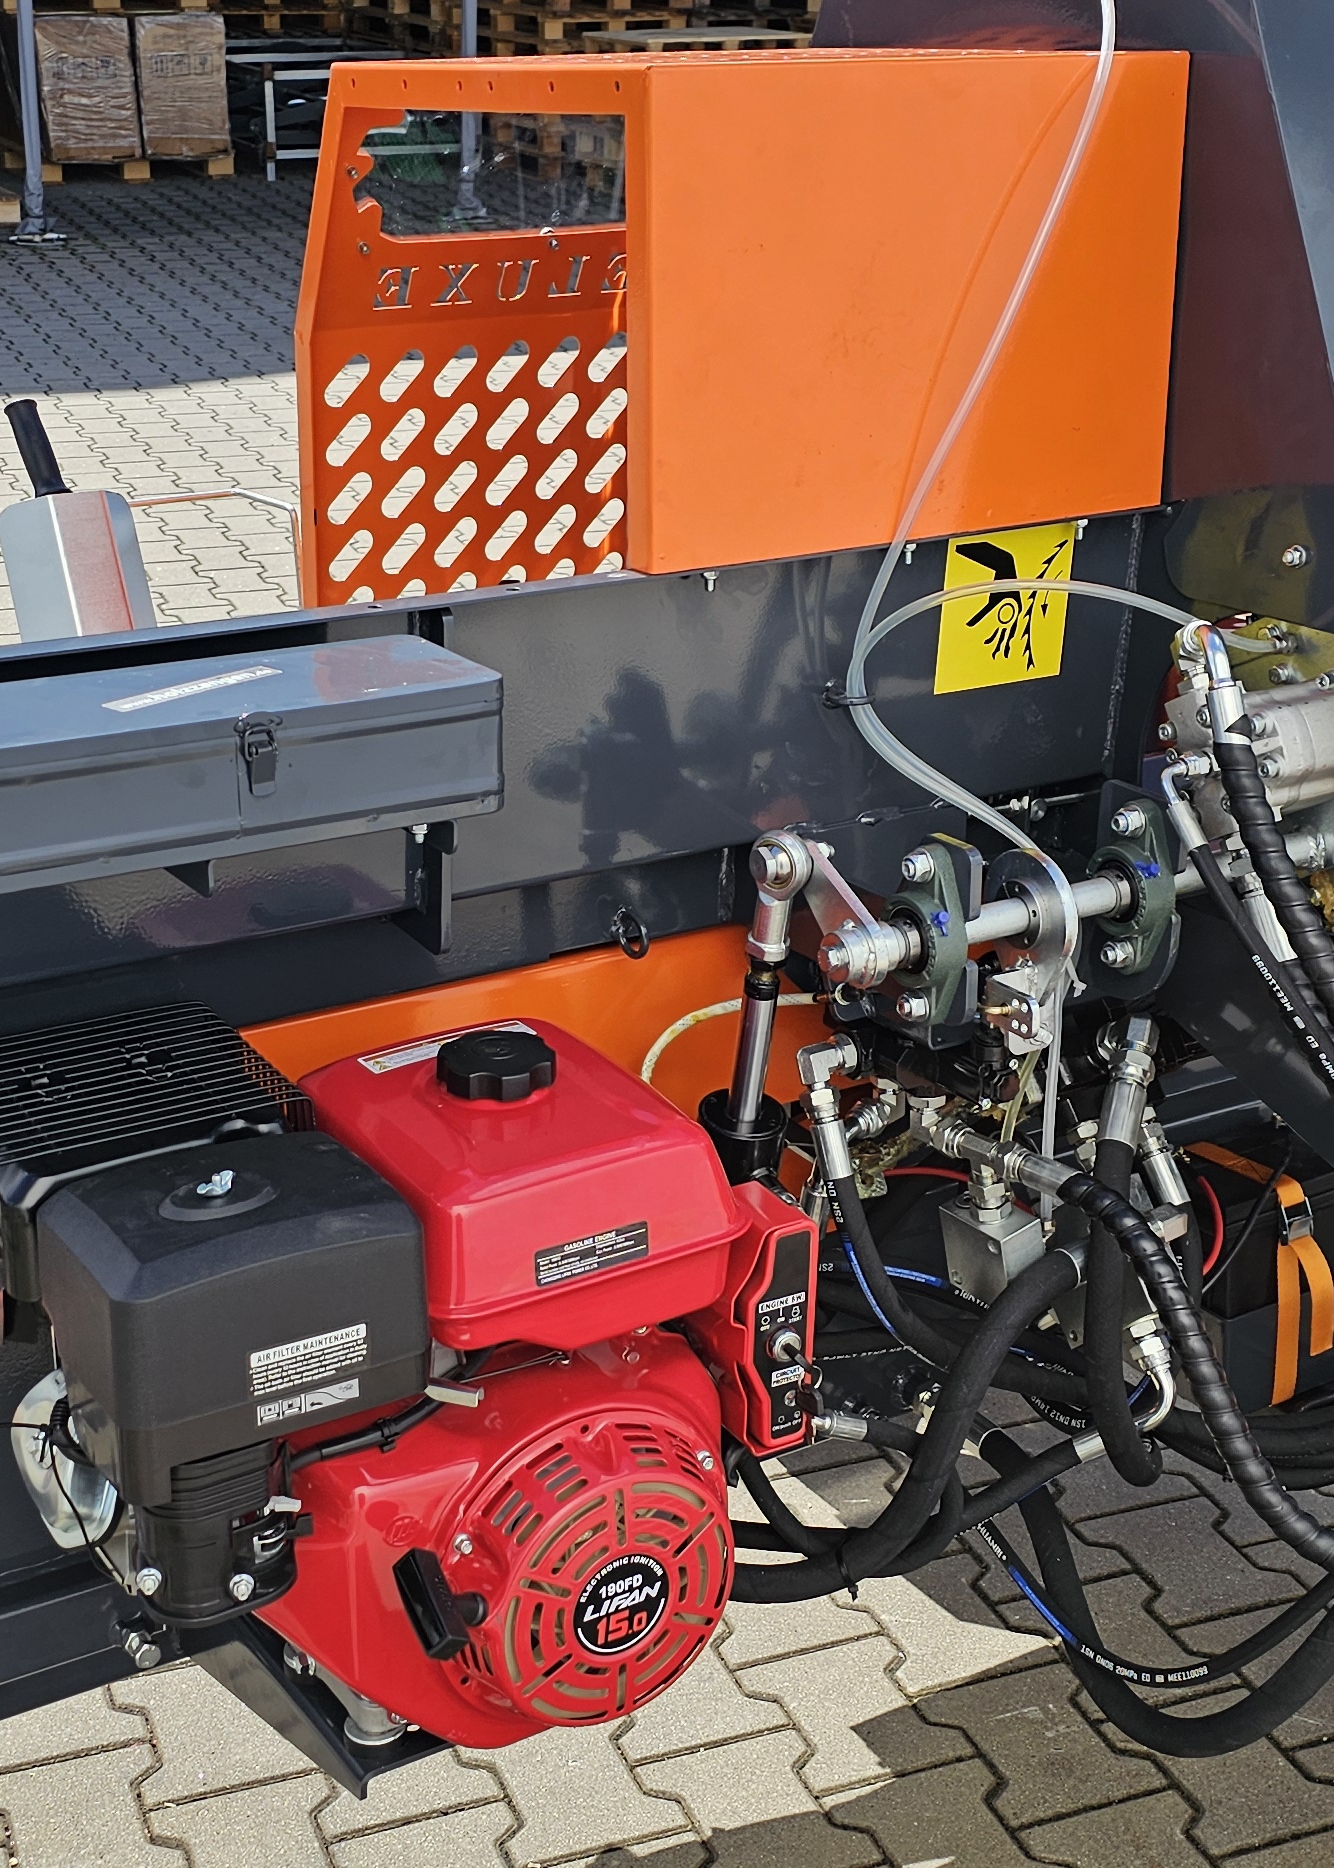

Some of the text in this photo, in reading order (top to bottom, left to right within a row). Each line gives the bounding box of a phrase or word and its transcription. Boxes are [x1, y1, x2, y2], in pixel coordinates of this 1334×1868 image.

[563, 1237, 594, 1252] GASOLINE
[594, 1230, 617, 1243] ENGINE
[760, 1298, 789, 1312] ENGINE
[257, 1327, 361, 1364] AIR FILTER MAINTENANCE
[772, 1372, 803, 1386] PROTECTO
[1049, 1409, 1071, 1426] DN12
[1070, 1418, 1086, 1429] 1SN
[579, 1555, 664, 1603] ELECTRONIC IGNITION
[598, 1573, 643, 1599] 190FD
[583, 1580, 662, 1622] LIFAN
[596, 1609, 648, 1645] 15.0
[1080, 1644, 1095, 1659] 1SN
[1095, 1654, 1114, 1671] DN06
[1167, 1665, 1209, 1683] MEE110099
